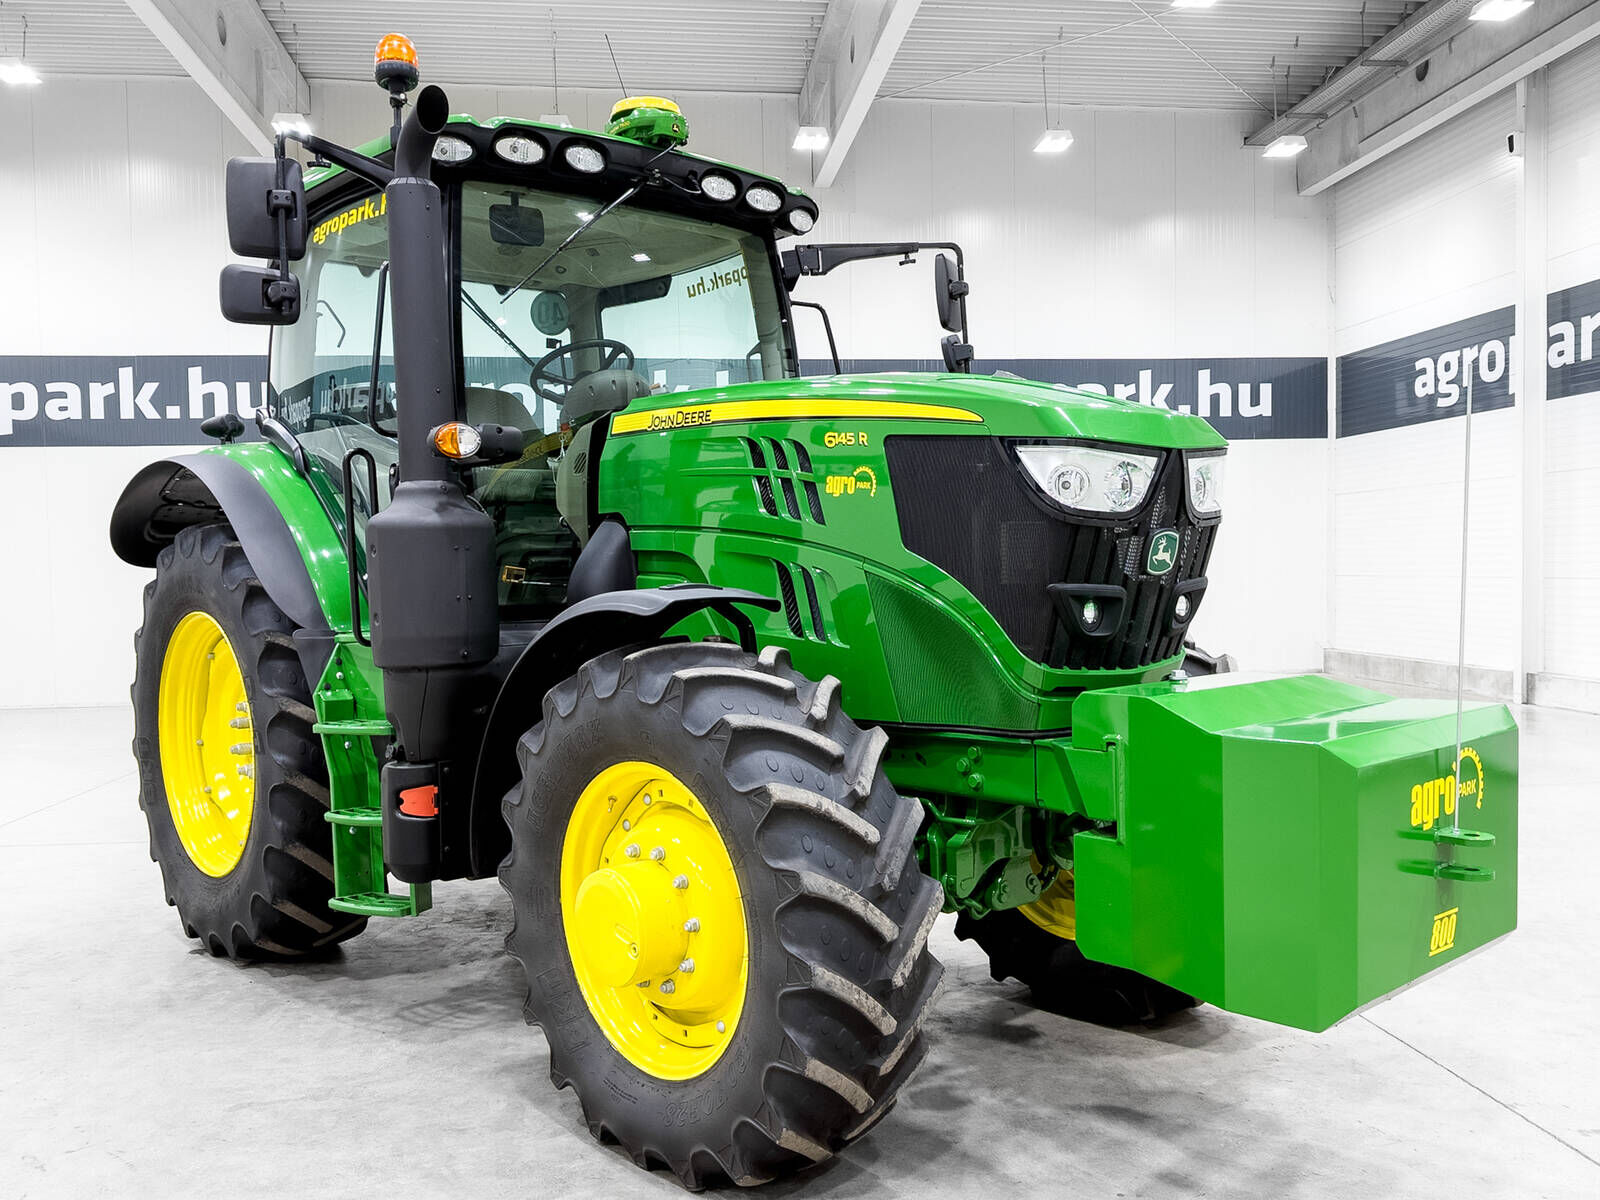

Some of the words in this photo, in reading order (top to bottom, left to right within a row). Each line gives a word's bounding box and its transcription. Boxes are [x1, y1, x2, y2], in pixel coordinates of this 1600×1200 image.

[647, 413, 676, 430] JOHN
[676, 409, 713, 426] DEERE
[823, 431, 856, 449] 6145
[825, 475, 856, 497] agro
[856, 481, 872, 490] PARK
[1410, 774, 1455, 831] agro
[1458, 779, 1477, 798] PARK
[1430, 913, 1457, 950] 800
